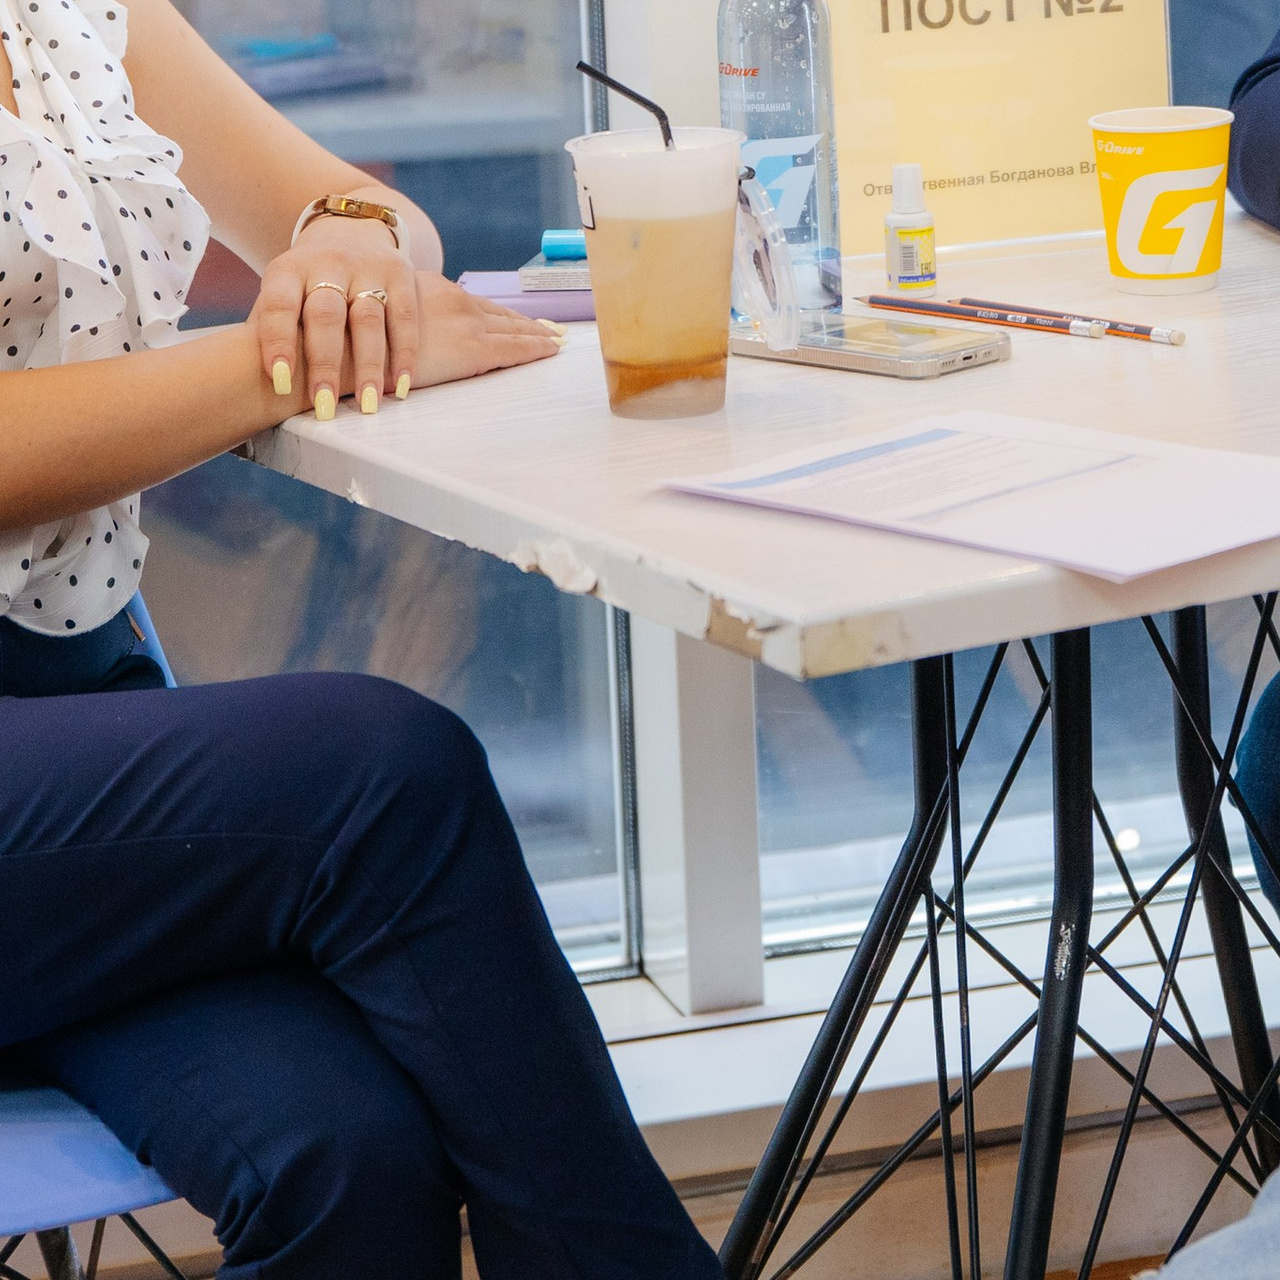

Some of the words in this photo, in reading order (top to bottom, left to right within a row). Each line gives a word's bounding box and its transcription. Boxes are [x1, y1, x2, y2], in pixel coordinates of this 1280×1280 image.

[863, 174, 985, 197] Отвтвенная
[990, 167, 1075, 184] Богданова
[1080, 161, 1098, 175] Вл
